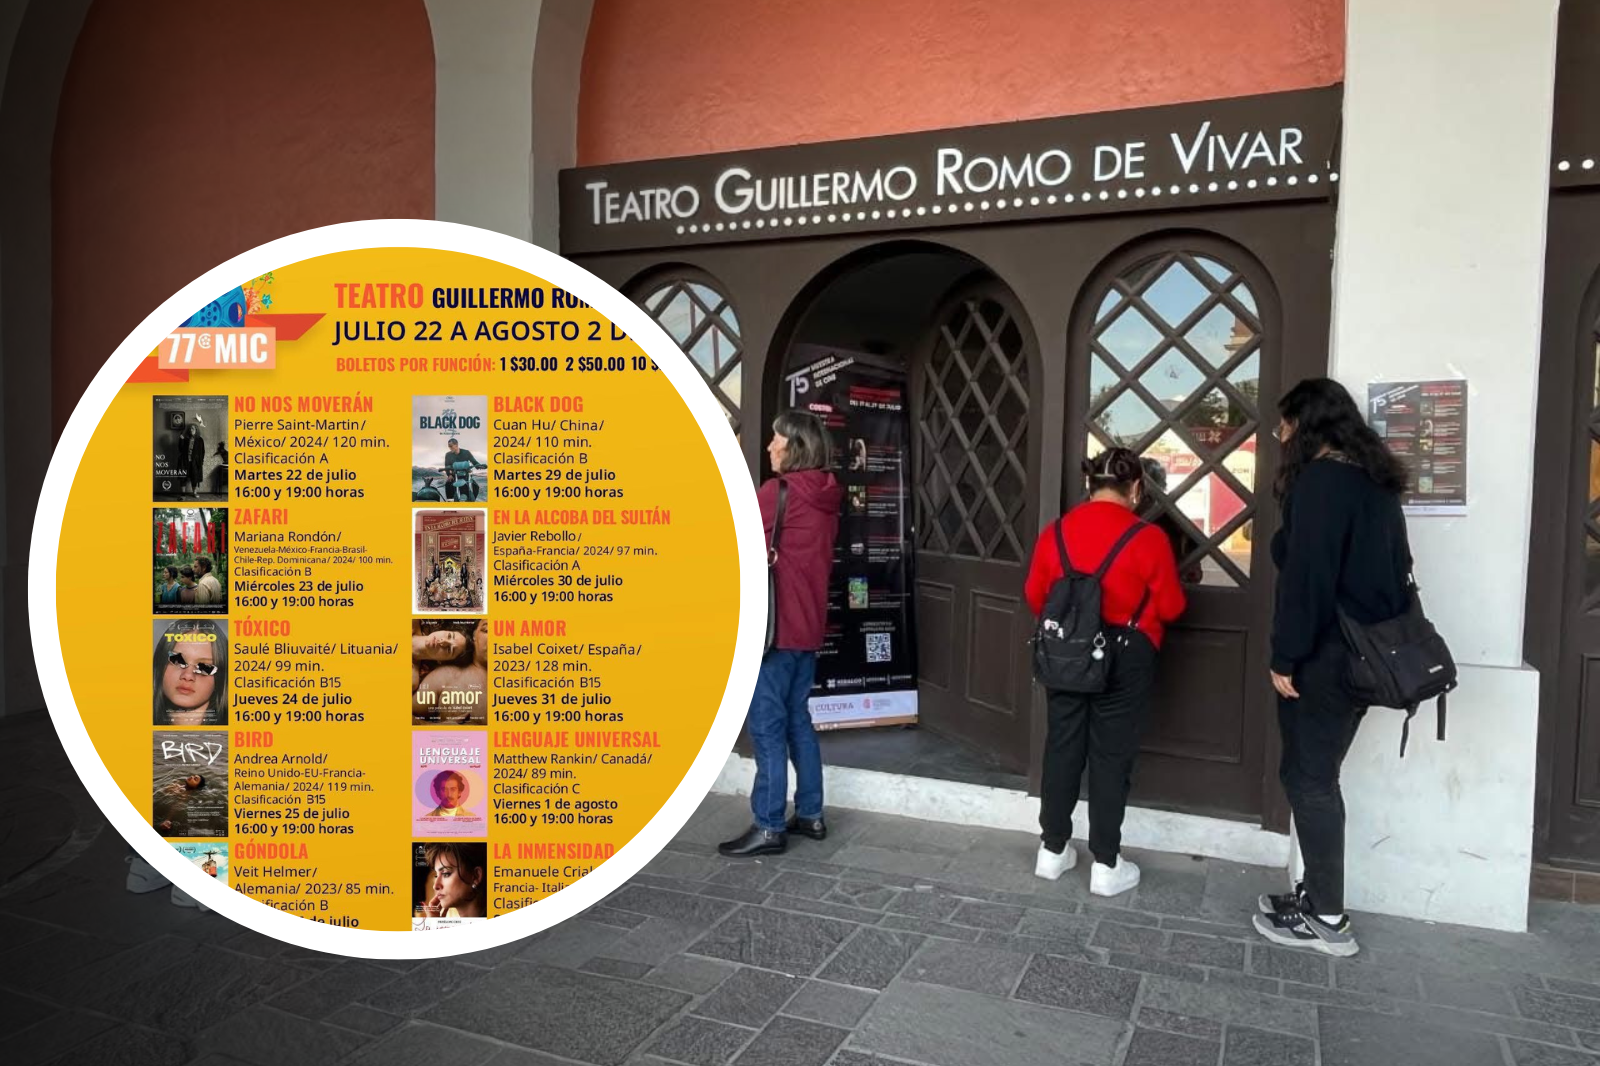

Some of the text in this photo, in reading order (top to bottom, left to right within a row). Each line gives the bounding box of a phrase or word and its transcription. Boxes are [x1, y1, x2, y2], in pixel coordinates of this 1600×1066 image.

[586, 121, 1303, 225] TEATRO GUILLERMO ROMO DE VIVAR
[815, 702, 855, 712] CULTURA
